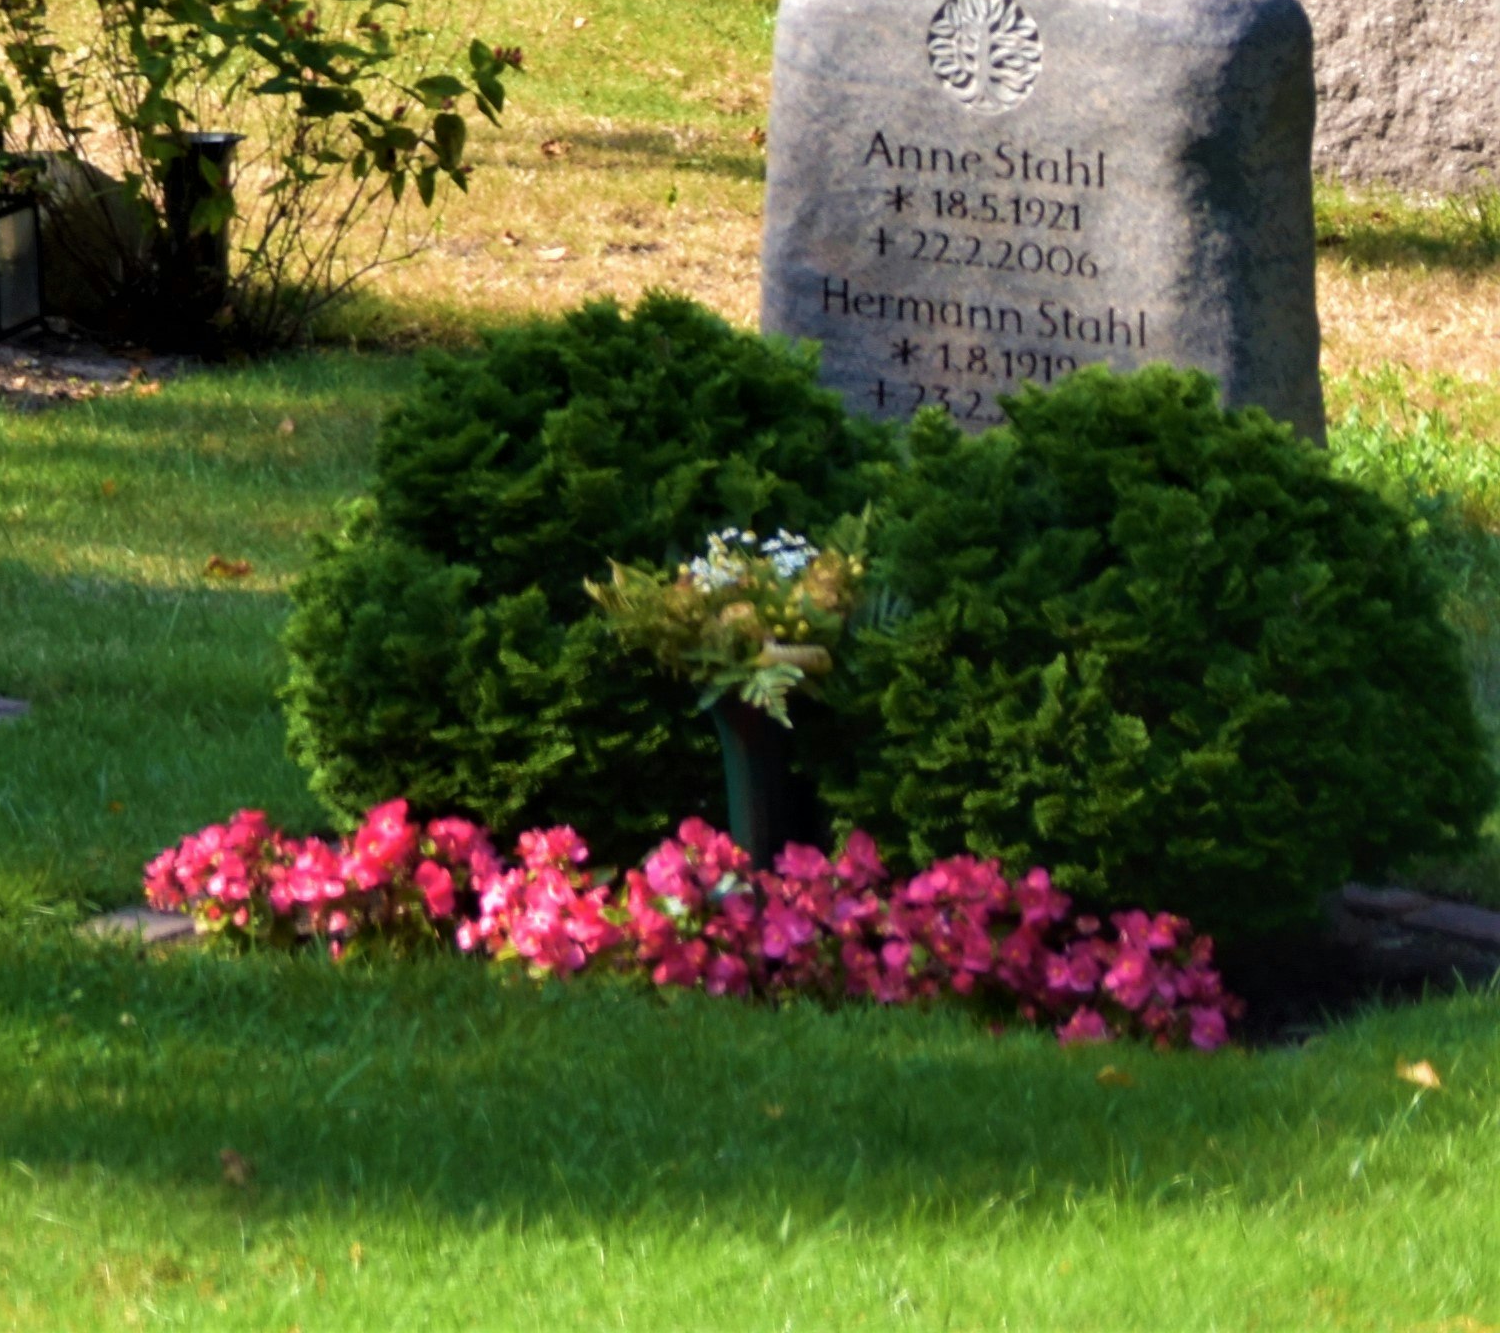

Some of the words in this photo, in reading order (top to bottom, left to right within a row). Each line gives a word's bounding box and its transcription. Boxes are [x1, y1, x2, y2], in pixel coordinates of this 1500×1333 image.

[863, 131, 983, 174] Anne
[995, 140, 1106, 189] Stahl
[932, 189, 1082, 232] 18.5.1921
[908, 230, 1100, 280] 22.2.2006
[822, 276, 1024, 335] Hermann
[1038, 300, 1147, 349] Stahl
